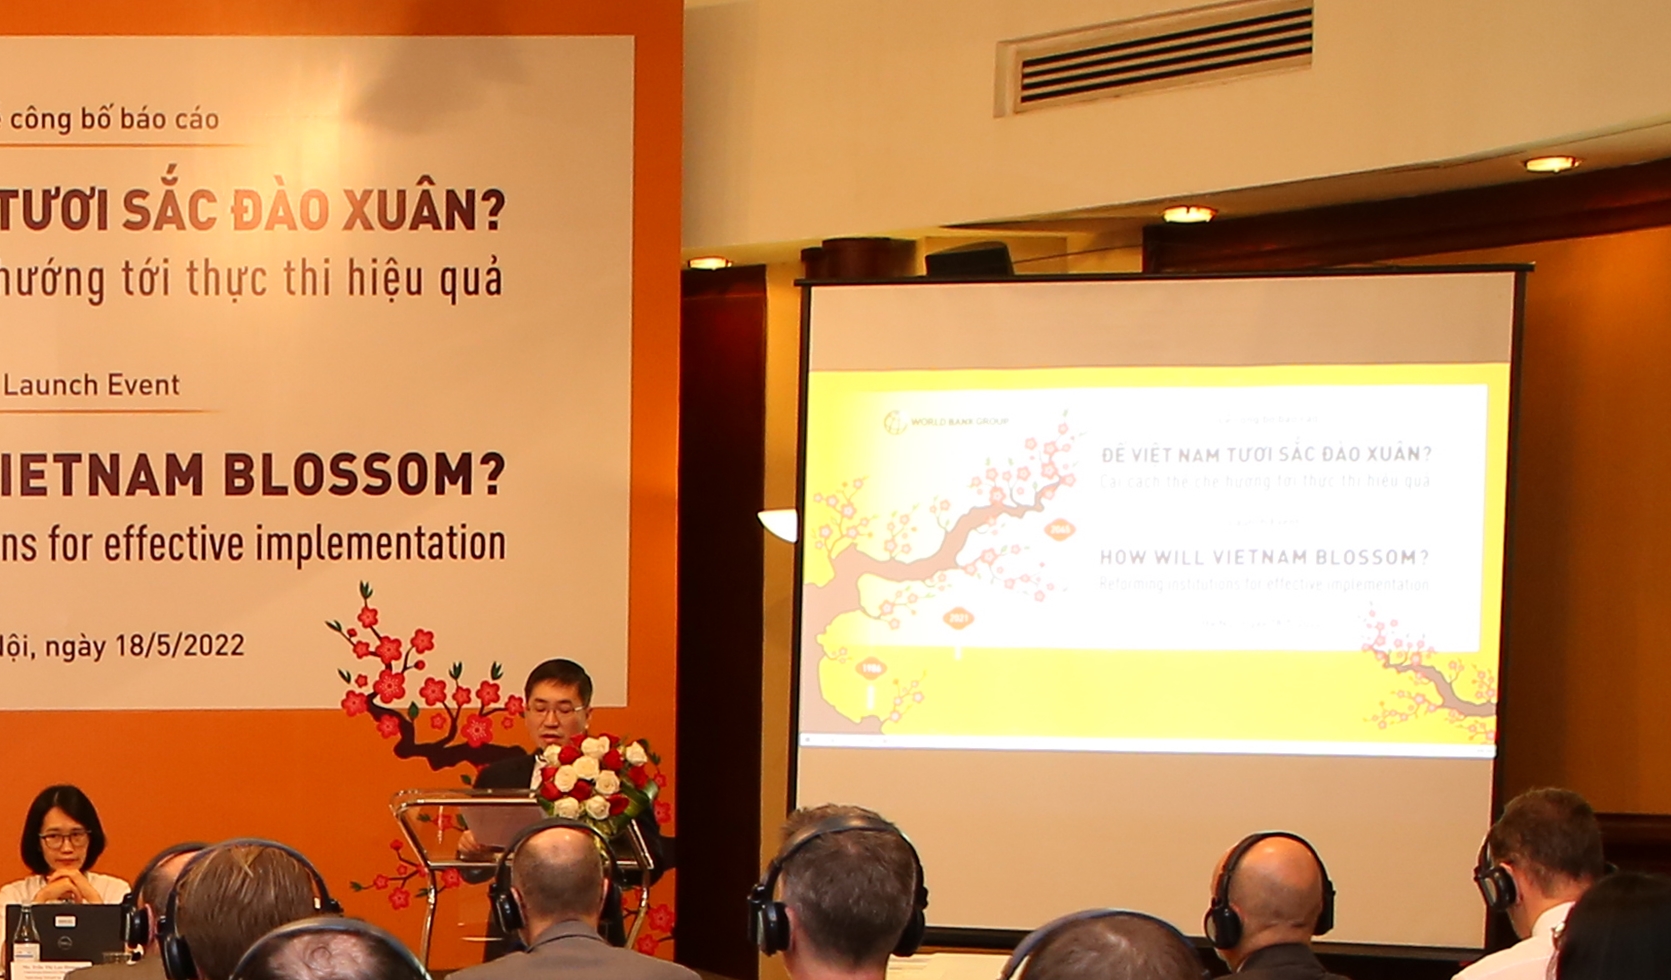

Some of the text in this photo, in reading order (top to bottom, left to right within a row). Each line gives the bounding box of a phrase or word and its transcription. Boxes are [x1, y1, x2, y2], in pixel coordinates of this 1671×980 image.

[11, 105, 71, 135] công
[82, 103, 114, 129] bố
[121, 105, 166, 129] báo
[176, 105, 218, 129] cáo
[122, 163, 216, 231] SẮC
[231, 175, 329, 231] ĐÀO
[344, 175, 505, 231] XUÂN?
[122, 257, 168, 296] tới
[186, 258, 266, 303] thực
[284, 258, 329, 296] thi
[349, 257, 421, 303] hiệu
[441, 255, 501, 305] quả
[5, 373, 179, 395] Launch Event
[1179, 448, 1220, 463] NAM
[225, 452, 505, 496] BLOSSOM?
[48, 524, 93, 561] for
[105, 524, 243, 561] effective
[257, 523, 505, 570] implementation
[1100, 549, 1428, 565] HOW WILL VIETNAM BLOSSOM?
[46, 633, 106, 662] ngày
[117, 632, 244, 658] 18/5/2022
